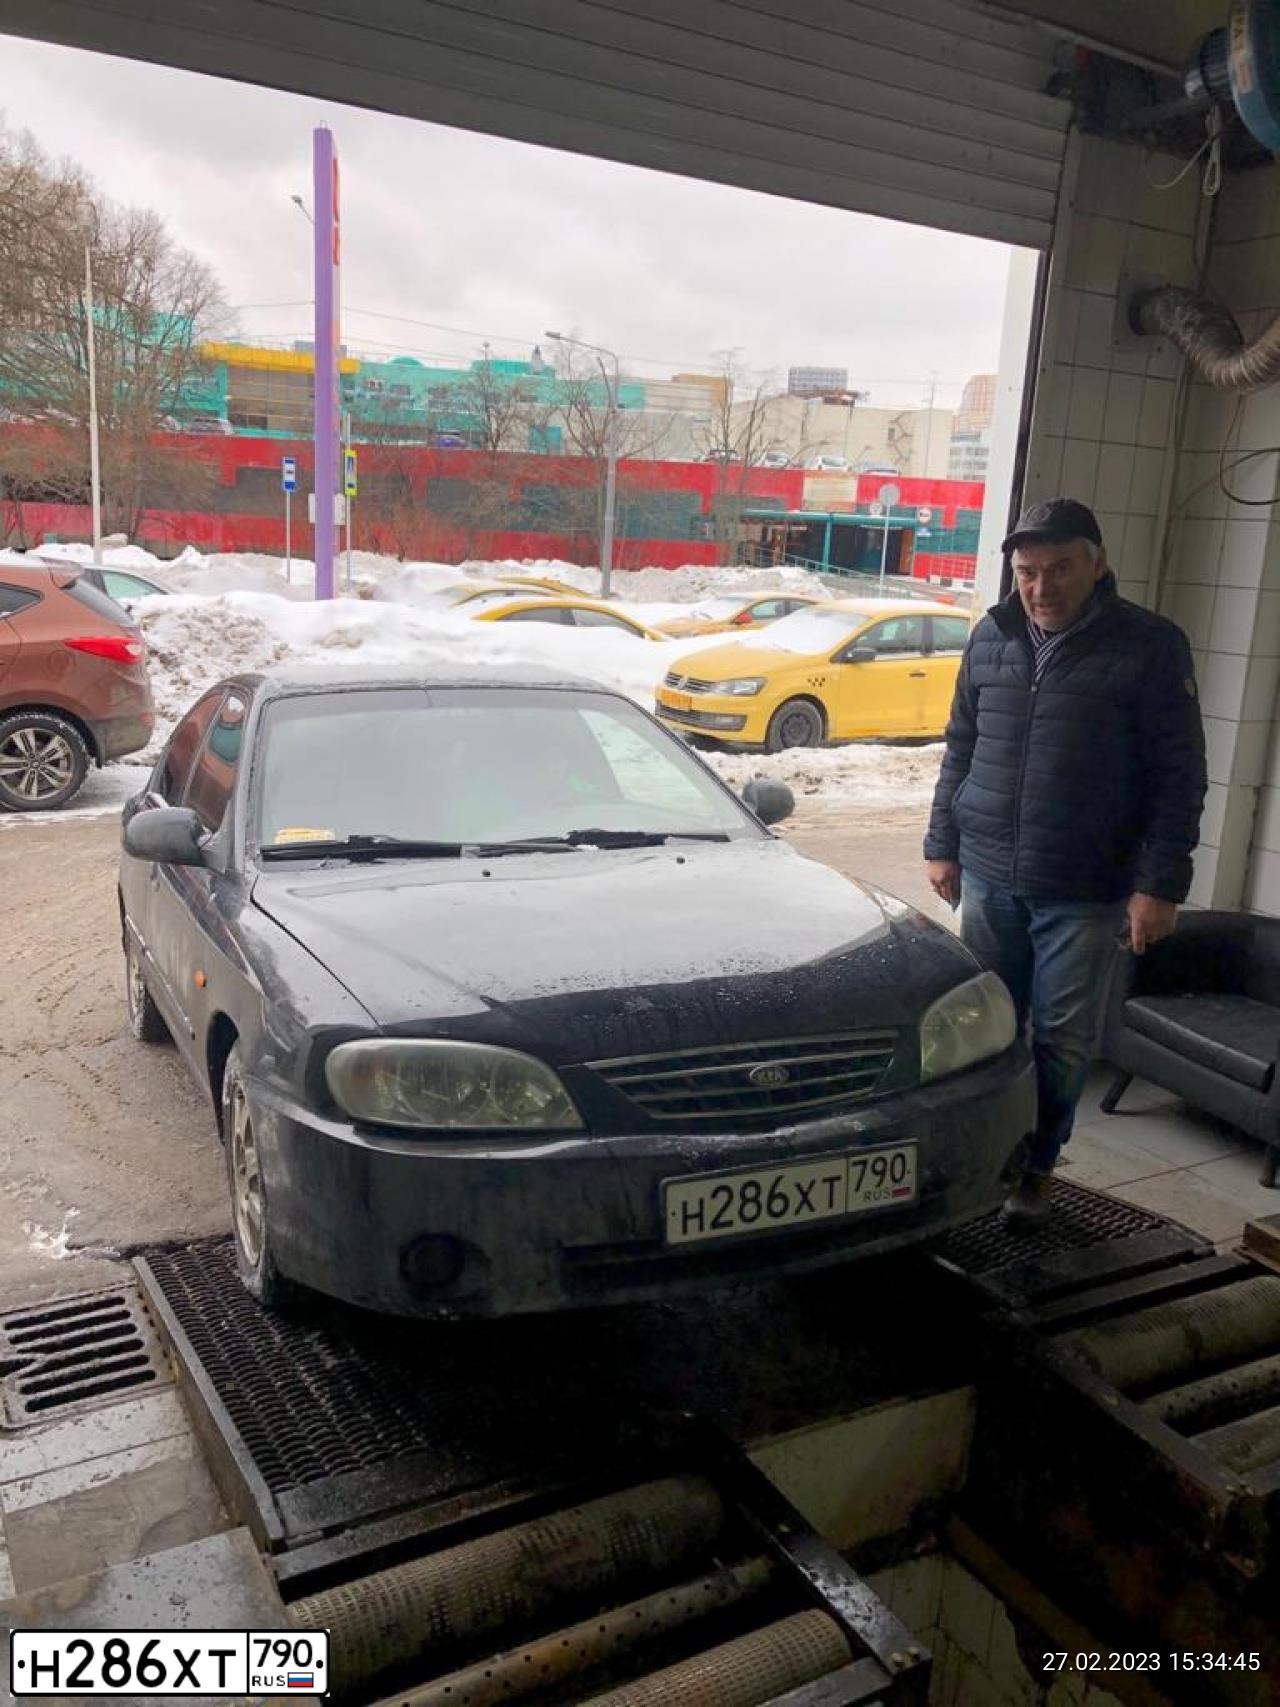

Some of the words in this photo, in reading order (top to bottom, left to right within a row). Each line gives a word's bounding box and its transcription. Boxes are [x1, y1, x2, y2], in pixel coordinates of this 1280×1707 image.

[681, 1174, 842, 1235] Н286ХТ
[851, 1152, 907, 1193] 790
[862, 1186, 890, 1202] RUS
